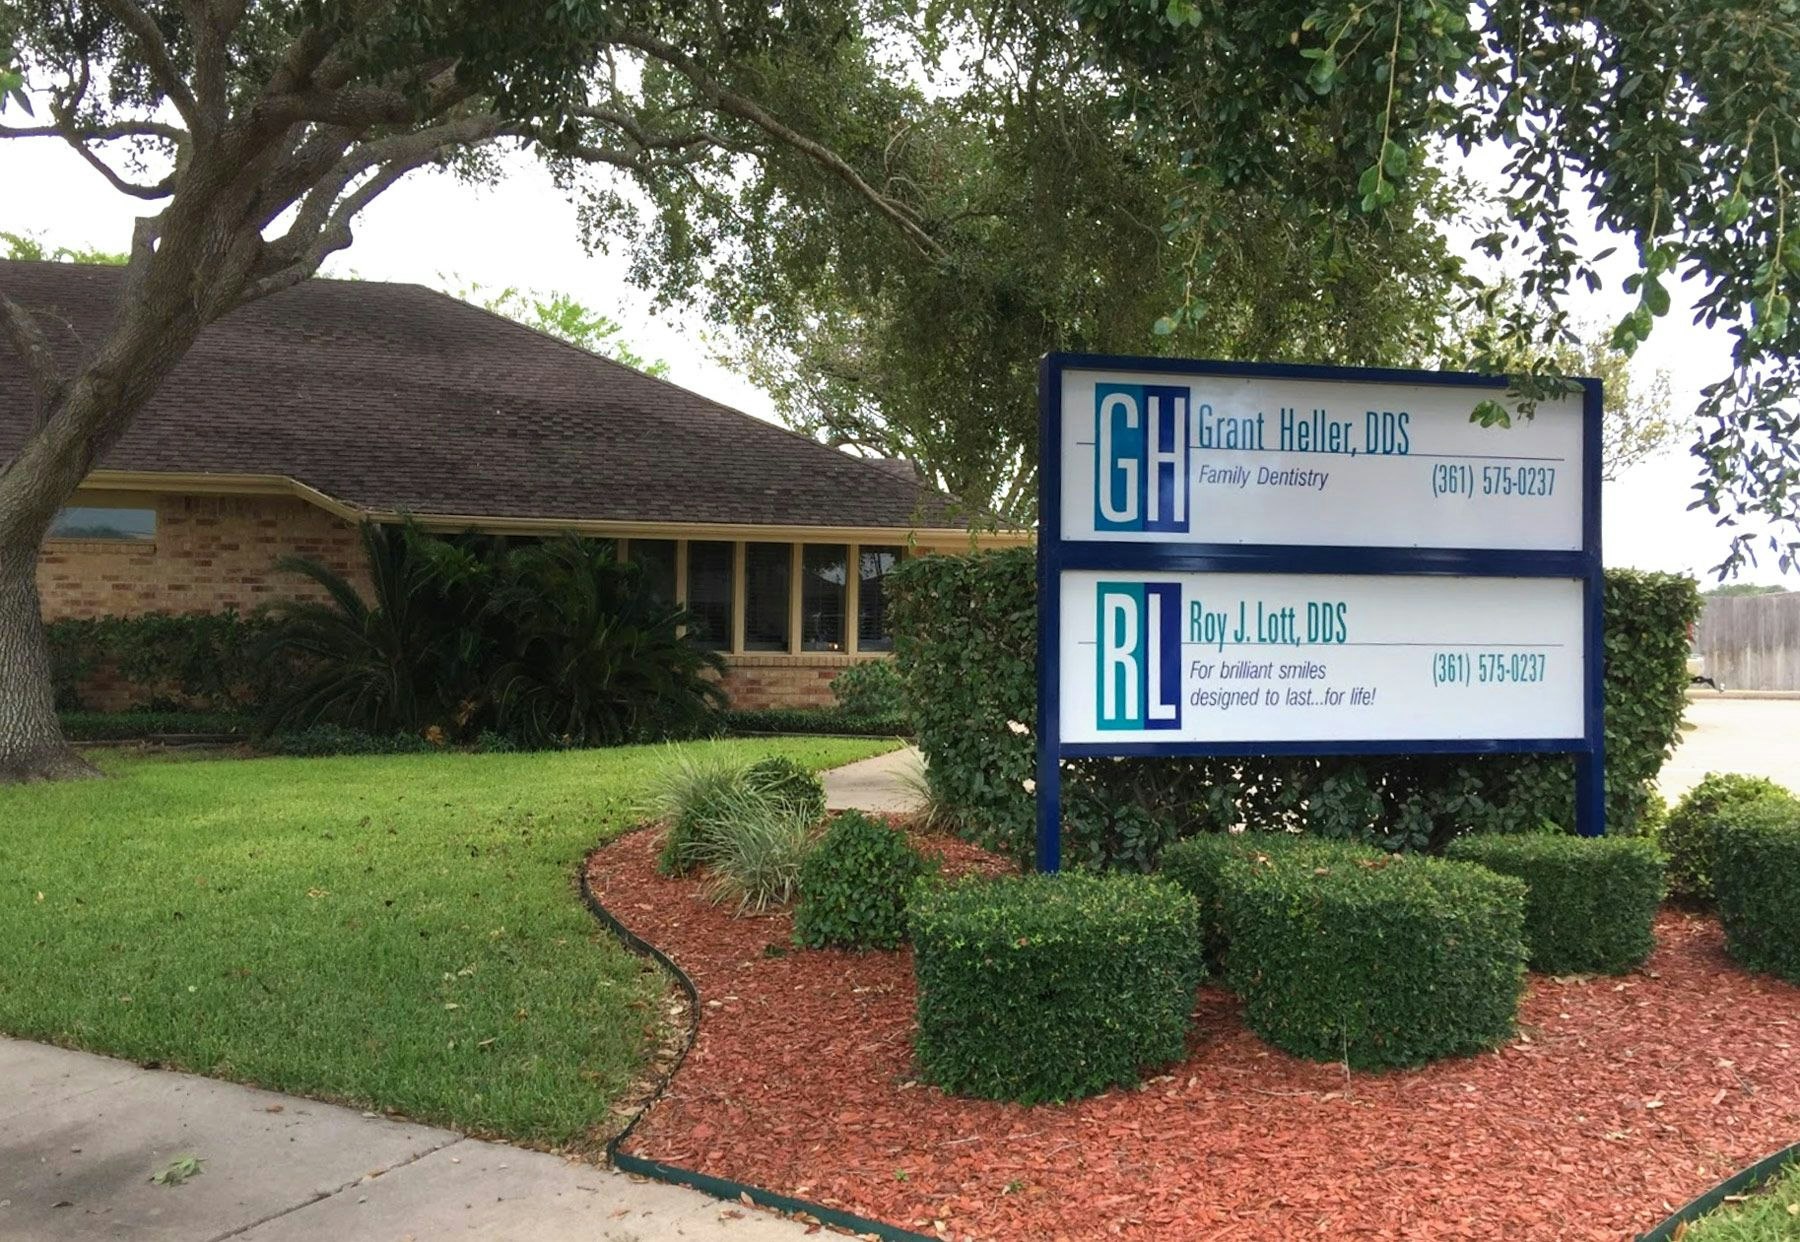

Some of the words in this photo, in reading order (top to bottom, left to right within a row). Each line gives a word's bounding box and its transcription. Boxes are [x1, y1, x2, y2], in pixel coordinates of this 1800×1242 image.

[1199, 404, 1264, 451] Grant
[1281, 409, 1356, 458] Heller,
[1366, 411, 1410, 455] DDS
[1100, 392, 1186, 523] GH
[1198, 464, 1251, 488] Family
[1257, 466, 1330, 491] Dentistry
[1432, 463, 1474, 499] (361)
[1482, 466, 1555, 497] 575-0237
[1190, 601, 1227, 652] Roy
[1233, 602, 1251, 644] J.
[1257, 602, 1300, 647] Lott,
[1307, 602, 1347, 644] DDS
[1103, 593, 1176, 720] RL
[1190, 660, 1214, 680] For
[1220, 660, 1273, 680] brilliant
[1278, 660, 1327, 681] smiles
[1432, 654, 1470, 688] (361)
[1479, 654, 1546, 684] 575-0237
[1190, 687, 1259, 711] designed
[1264, 690, 1280, 706] to
[1349, 687, 1377, 707] life!
